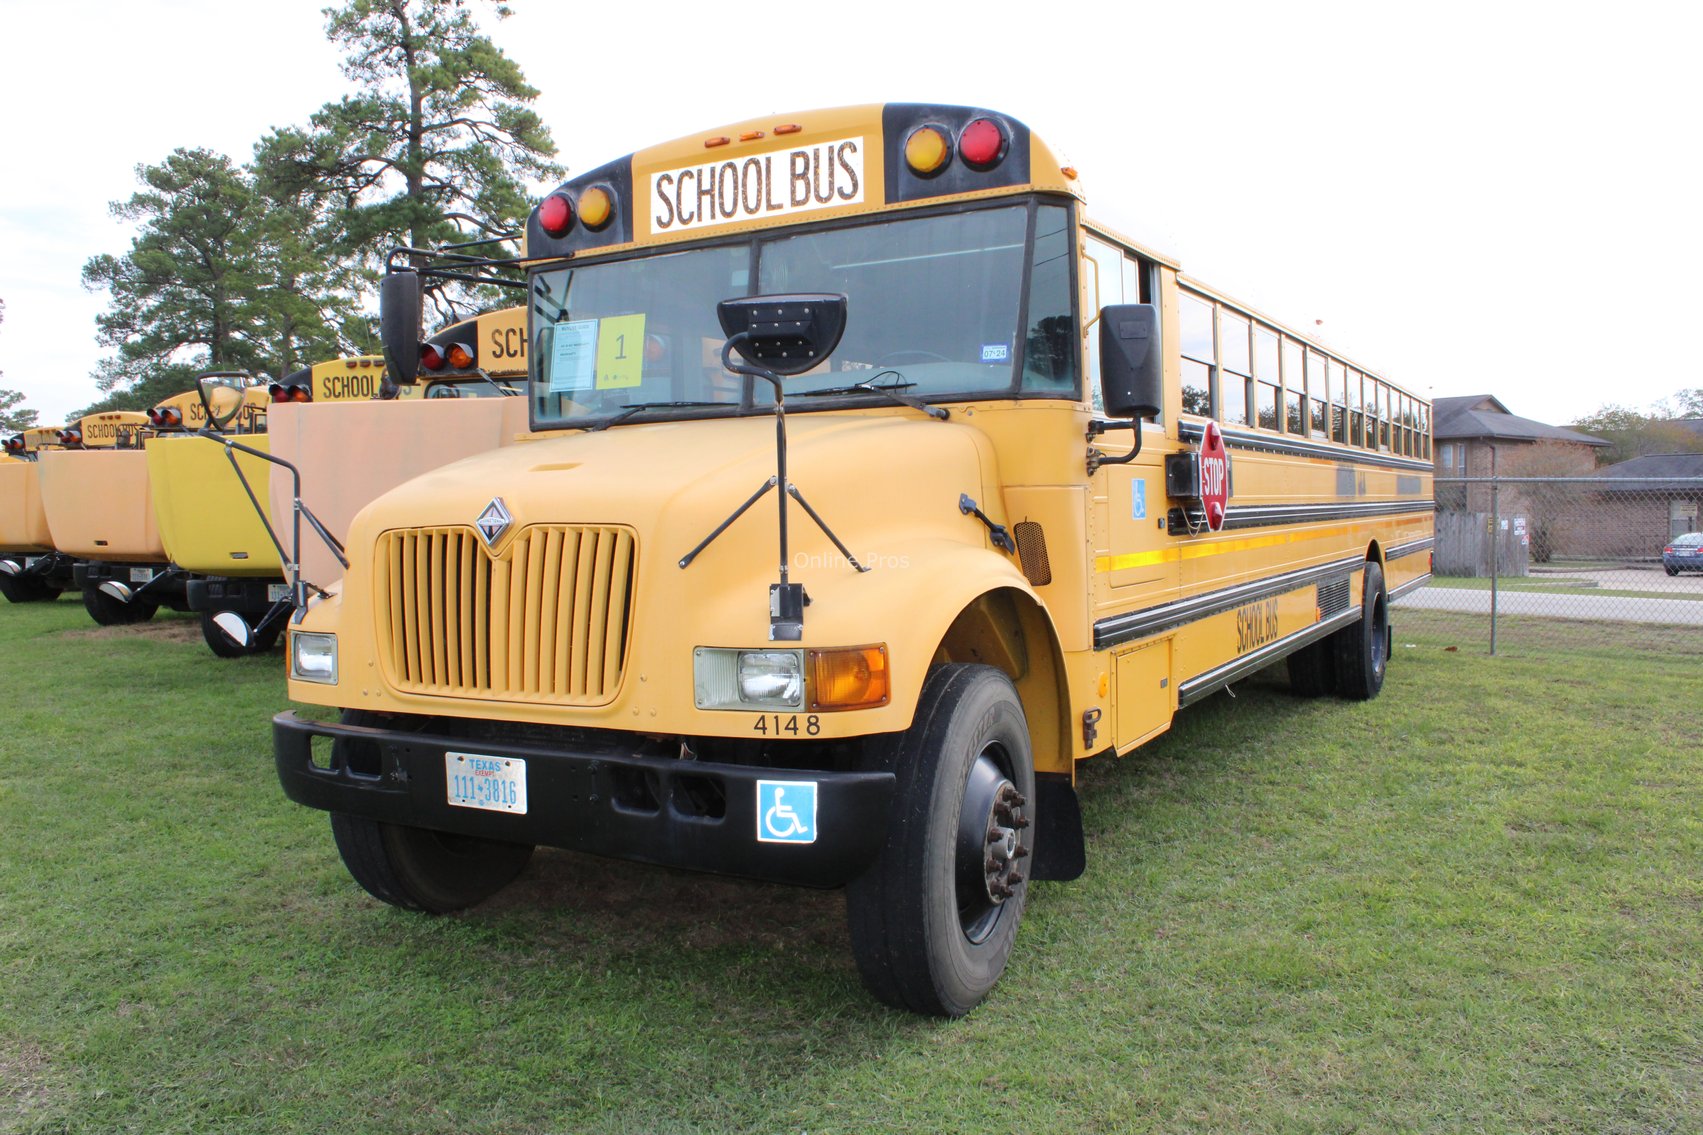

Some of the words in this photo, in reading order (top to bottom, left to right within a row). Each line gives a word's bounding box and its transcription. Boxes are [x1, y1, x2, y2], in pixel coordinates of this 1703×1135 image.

[656, 156, 784, 229] SCHOOL
[790, 141, 859, 208] BUS
[491, 327, 528, 359] SCH
[614, 334, 627, 360] 1
[323, 375, 378, 399] SCHOOL
[1204, 456, 1224, 496] STOP
[1236, 602, 1264, 654] SCHOOL
[1266, 597, 1278, 642] BUS
[753, 714, 821, 736] 4148
[468, 758, 501, 772] TEXAS
